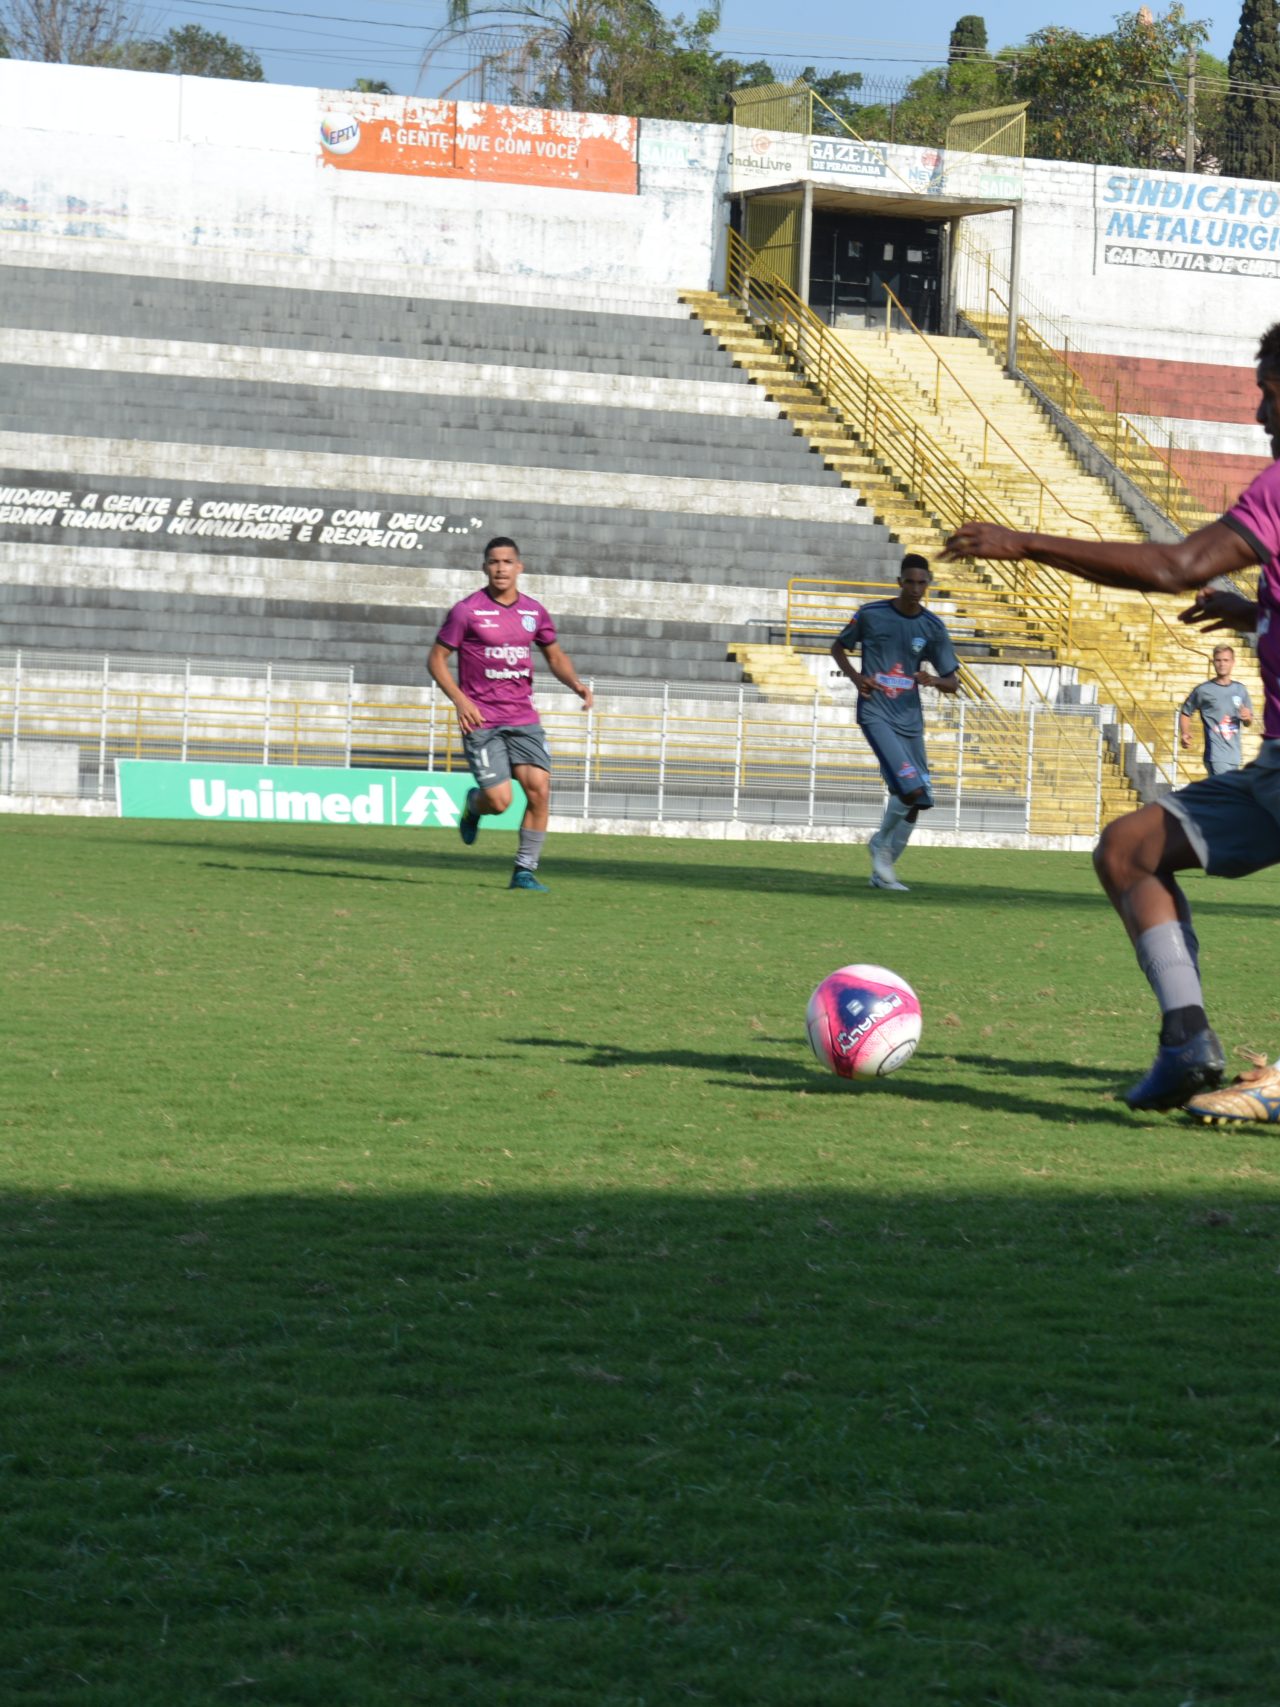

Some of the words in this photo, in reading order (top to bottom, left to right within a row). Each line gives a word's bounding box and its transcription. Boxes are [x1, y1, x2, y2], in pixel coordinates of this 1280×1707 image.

[329, 122, 360, 146] EPTV
[380, 127, 392, 144] A
[397, 128, 449, 150] GENTE
[455, 133, 491, 152] VIVE
[494, 137, 531, 155] COM
[535, 140, 577, 160] VOCÊ
[811, 141, 885, 166] GAZETA
[813, 160, 824, 170] DE
[826, 161, 881, 175] PIRACICABA
[1102, 175, 1280, 218] SINDICATO
[60, 509, 164, 532] TRADIÇÃO
[167, 517, 294, 542] HUMILDADE
[296, 525, 313, 542] E
[319, 526, 424, 550] RESPEITO.
[80, 493, 99, 511] A
[103, 493, 172, 516] GENTE
[199, 501, 325, 525] CONECTADO
[331, 509, 381, 529] COM
[388, 512, 446, 533] DEUS
[189, 778, 384, 825] Unimed
[840, 994, 903, 1055] PENALTY
